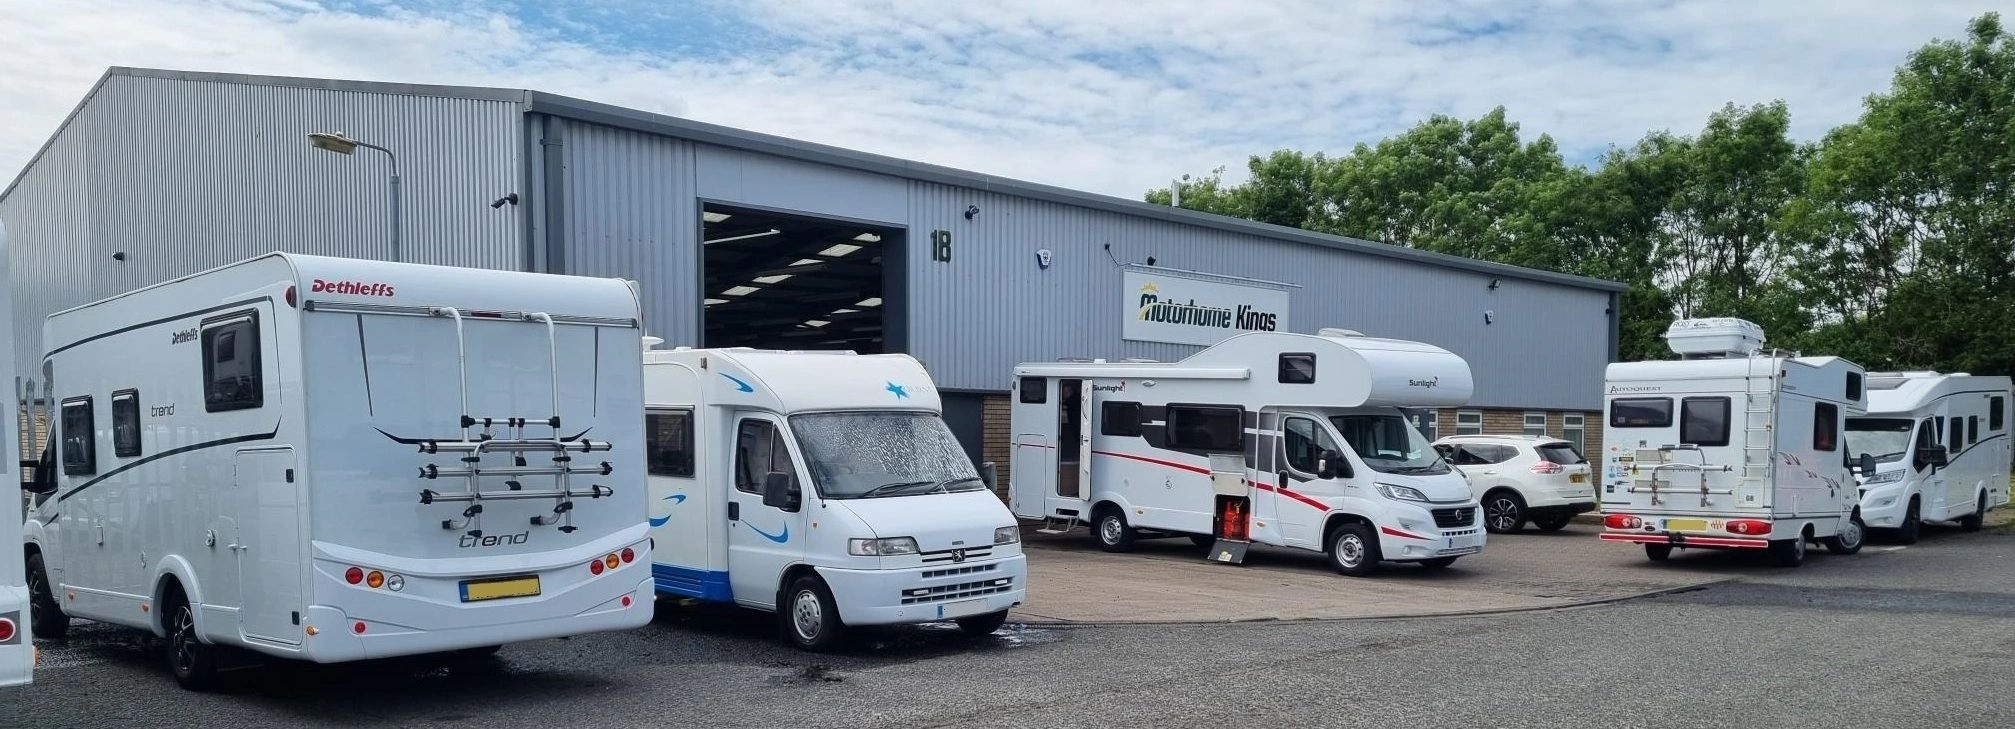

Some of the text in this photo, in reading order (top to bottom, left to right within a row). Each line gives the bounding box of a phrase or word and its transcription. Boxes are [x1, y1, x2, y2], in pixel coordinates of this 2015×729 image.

[311, 279, 395, 297] Dethleffs
[1138, 293, 1277, 332] Motorhome Kings
[172, 328, 198, 345] Dethleffs
[1092, 383, 1125, 393] Sunlight
[1408, 378, 1437, 389] Sunlight
[151, 402, 175, 417] trend
[458, 529, 530, 548] trend
